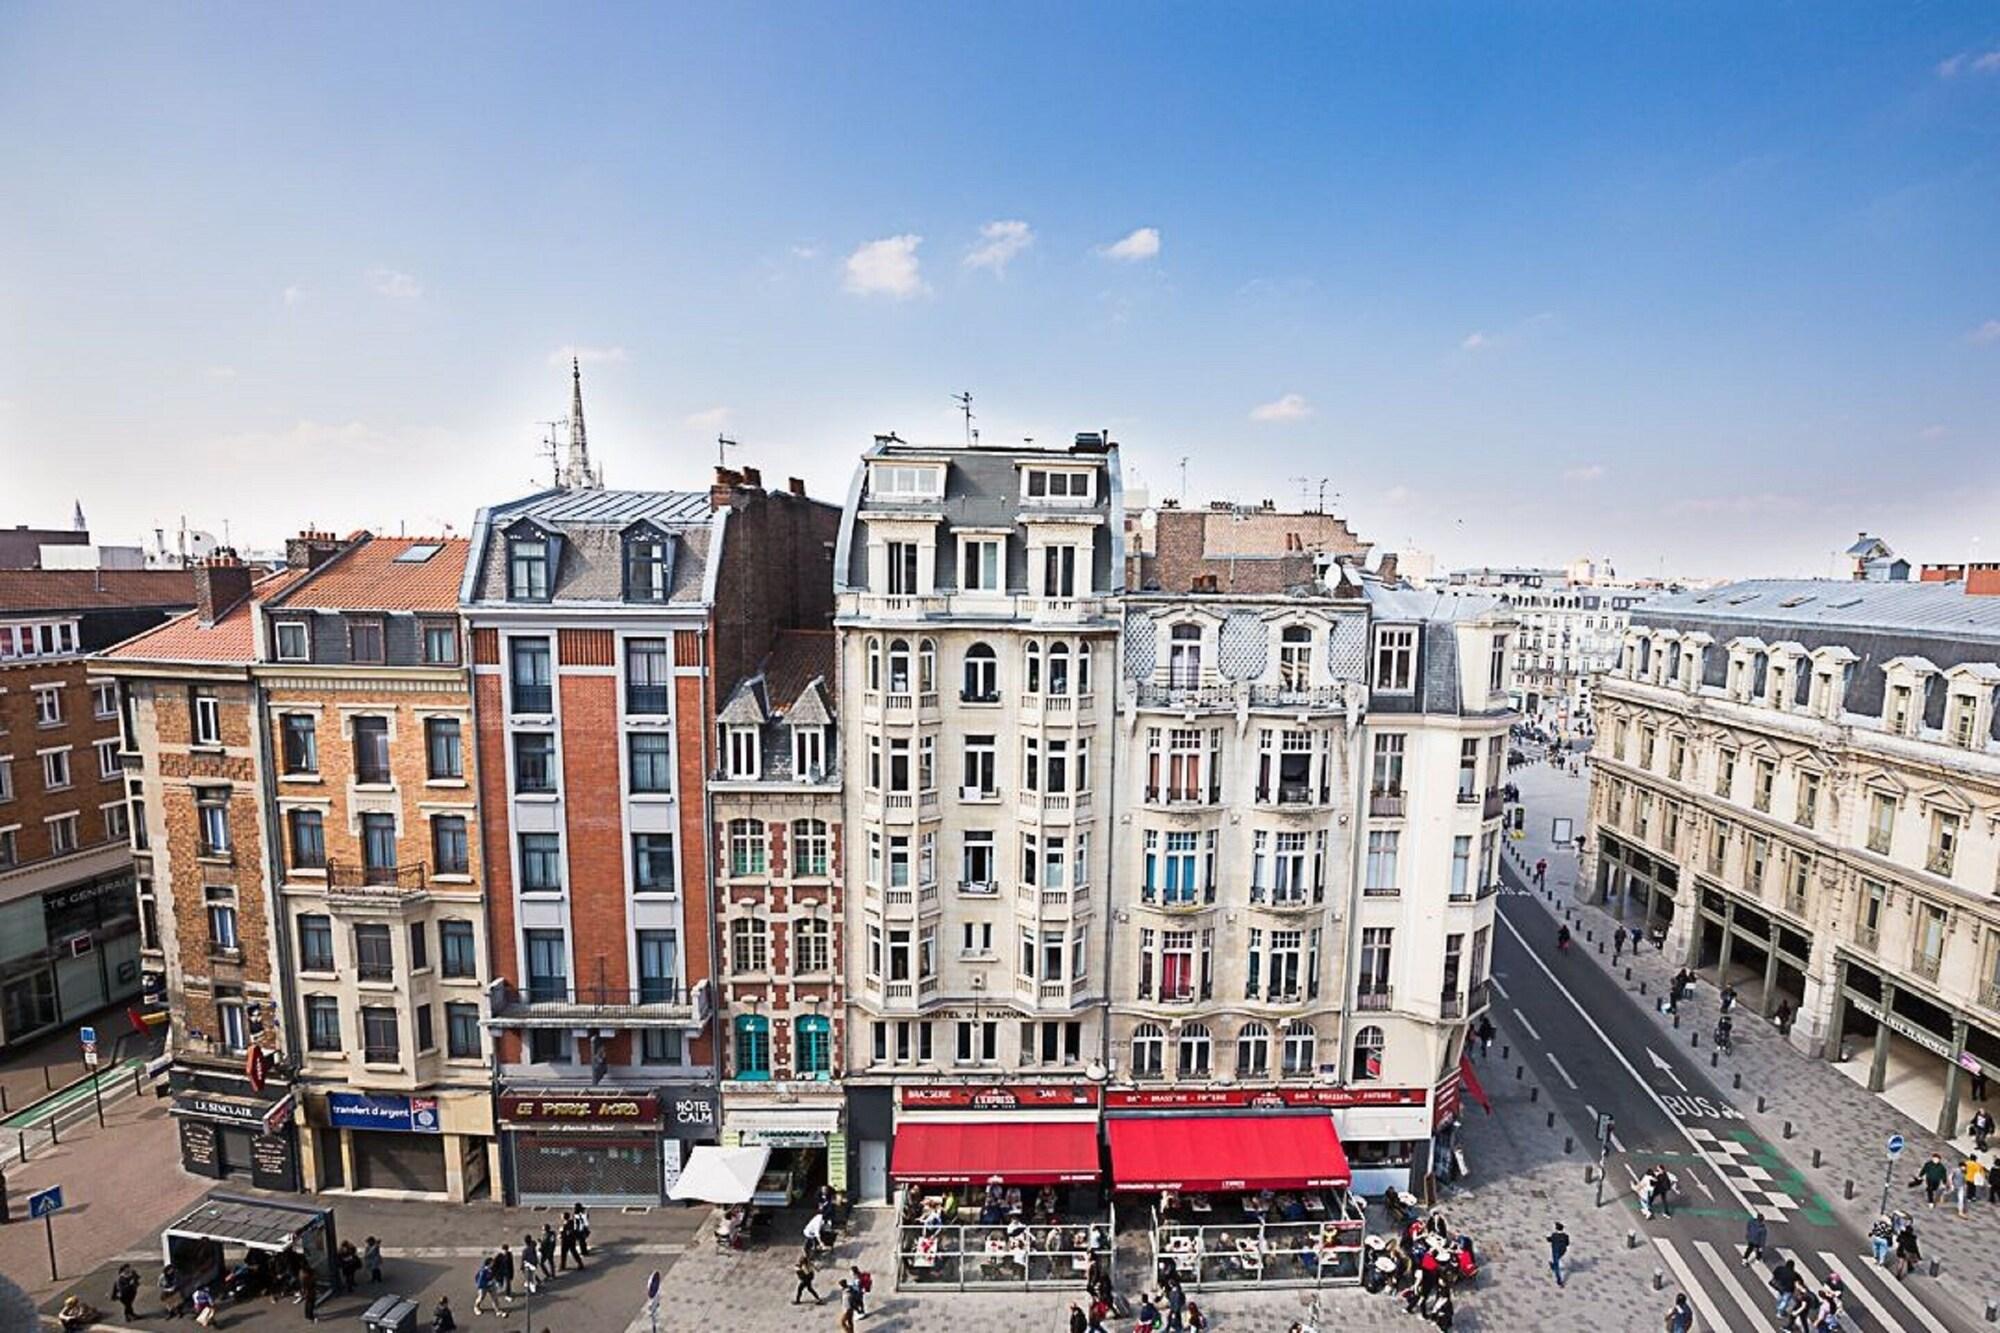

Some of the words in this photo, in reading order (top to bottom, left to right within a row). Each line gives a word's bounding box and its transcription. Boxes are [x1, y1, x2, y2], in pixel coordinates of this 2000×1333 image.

[195, 1101, 208, 1111] LE
[208, 1103, 253, 1117] SINCLAIR
[676, 1100, 712, 1111] HÔTEL
[1661, 1095, 1720, 1119] BUS
[677, 1112, 713, 1123] CALM
